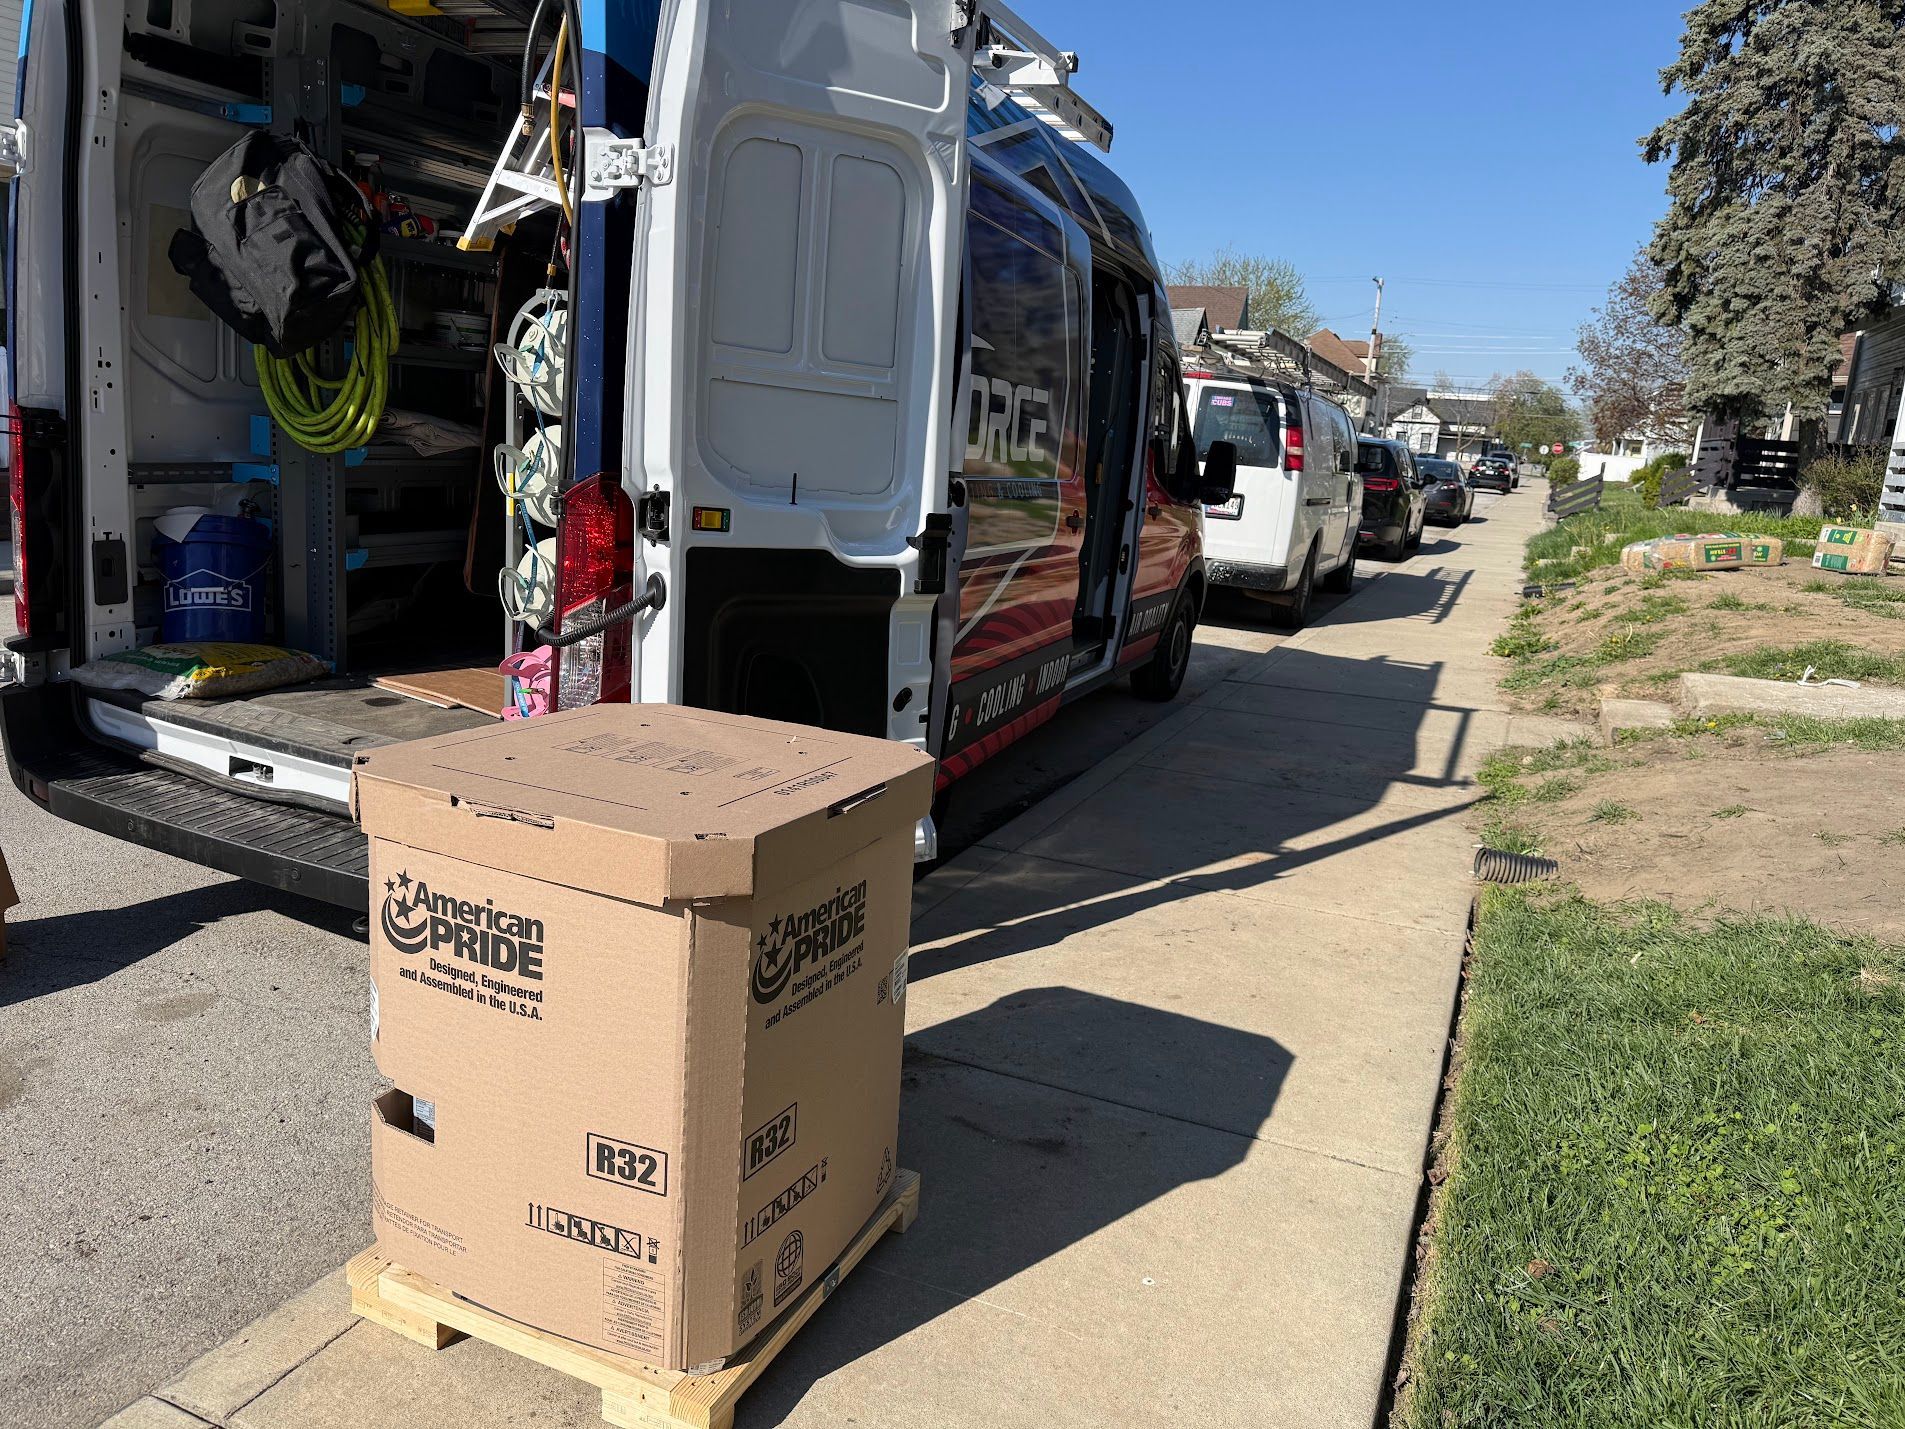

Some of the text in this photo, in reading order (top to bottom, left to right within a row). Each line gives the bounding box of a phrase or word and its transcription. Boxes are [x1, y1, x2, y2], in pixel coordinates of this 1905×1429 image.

[1210, 399, 1232, 407] CUBS
[1006, 481, 1042, 499] COOLING
[169, 587, 243, 606] LOWE'S
[976, 673, 1026, 727] COOLING
[1036, 654, 1070, 696] INDOOR
[1128, 611, 1142, 637] AIR
[1142, 602, 1169, 632] QUALITY
[412, 881, 544, 944] American
[780, 879, 867, 946] American
[793, 900, 866, 976] PRIDE
[429, 914, 544, 981] PRIDE
[791, 939, 864, 997] Designed, Engineered
[399, 966, 544, 1021] and Assembled in the U.S.A.
[429, 957, 543, 1003] Designed, Engineered
[765, 957, 863, 1030] and Assembled in the U.S.A.
[596, 1141, 658, 1187] R32
[751, 1114, 791, 1171] R32
[394, 1206, 464, 1244] RETAINER FOR TRANSPORT
[414, 1224, 428, 1236] PARA
[428, 1231, 467, 1253] TRANSPORTAR
[433, 1240, 449, 1253] POUR
